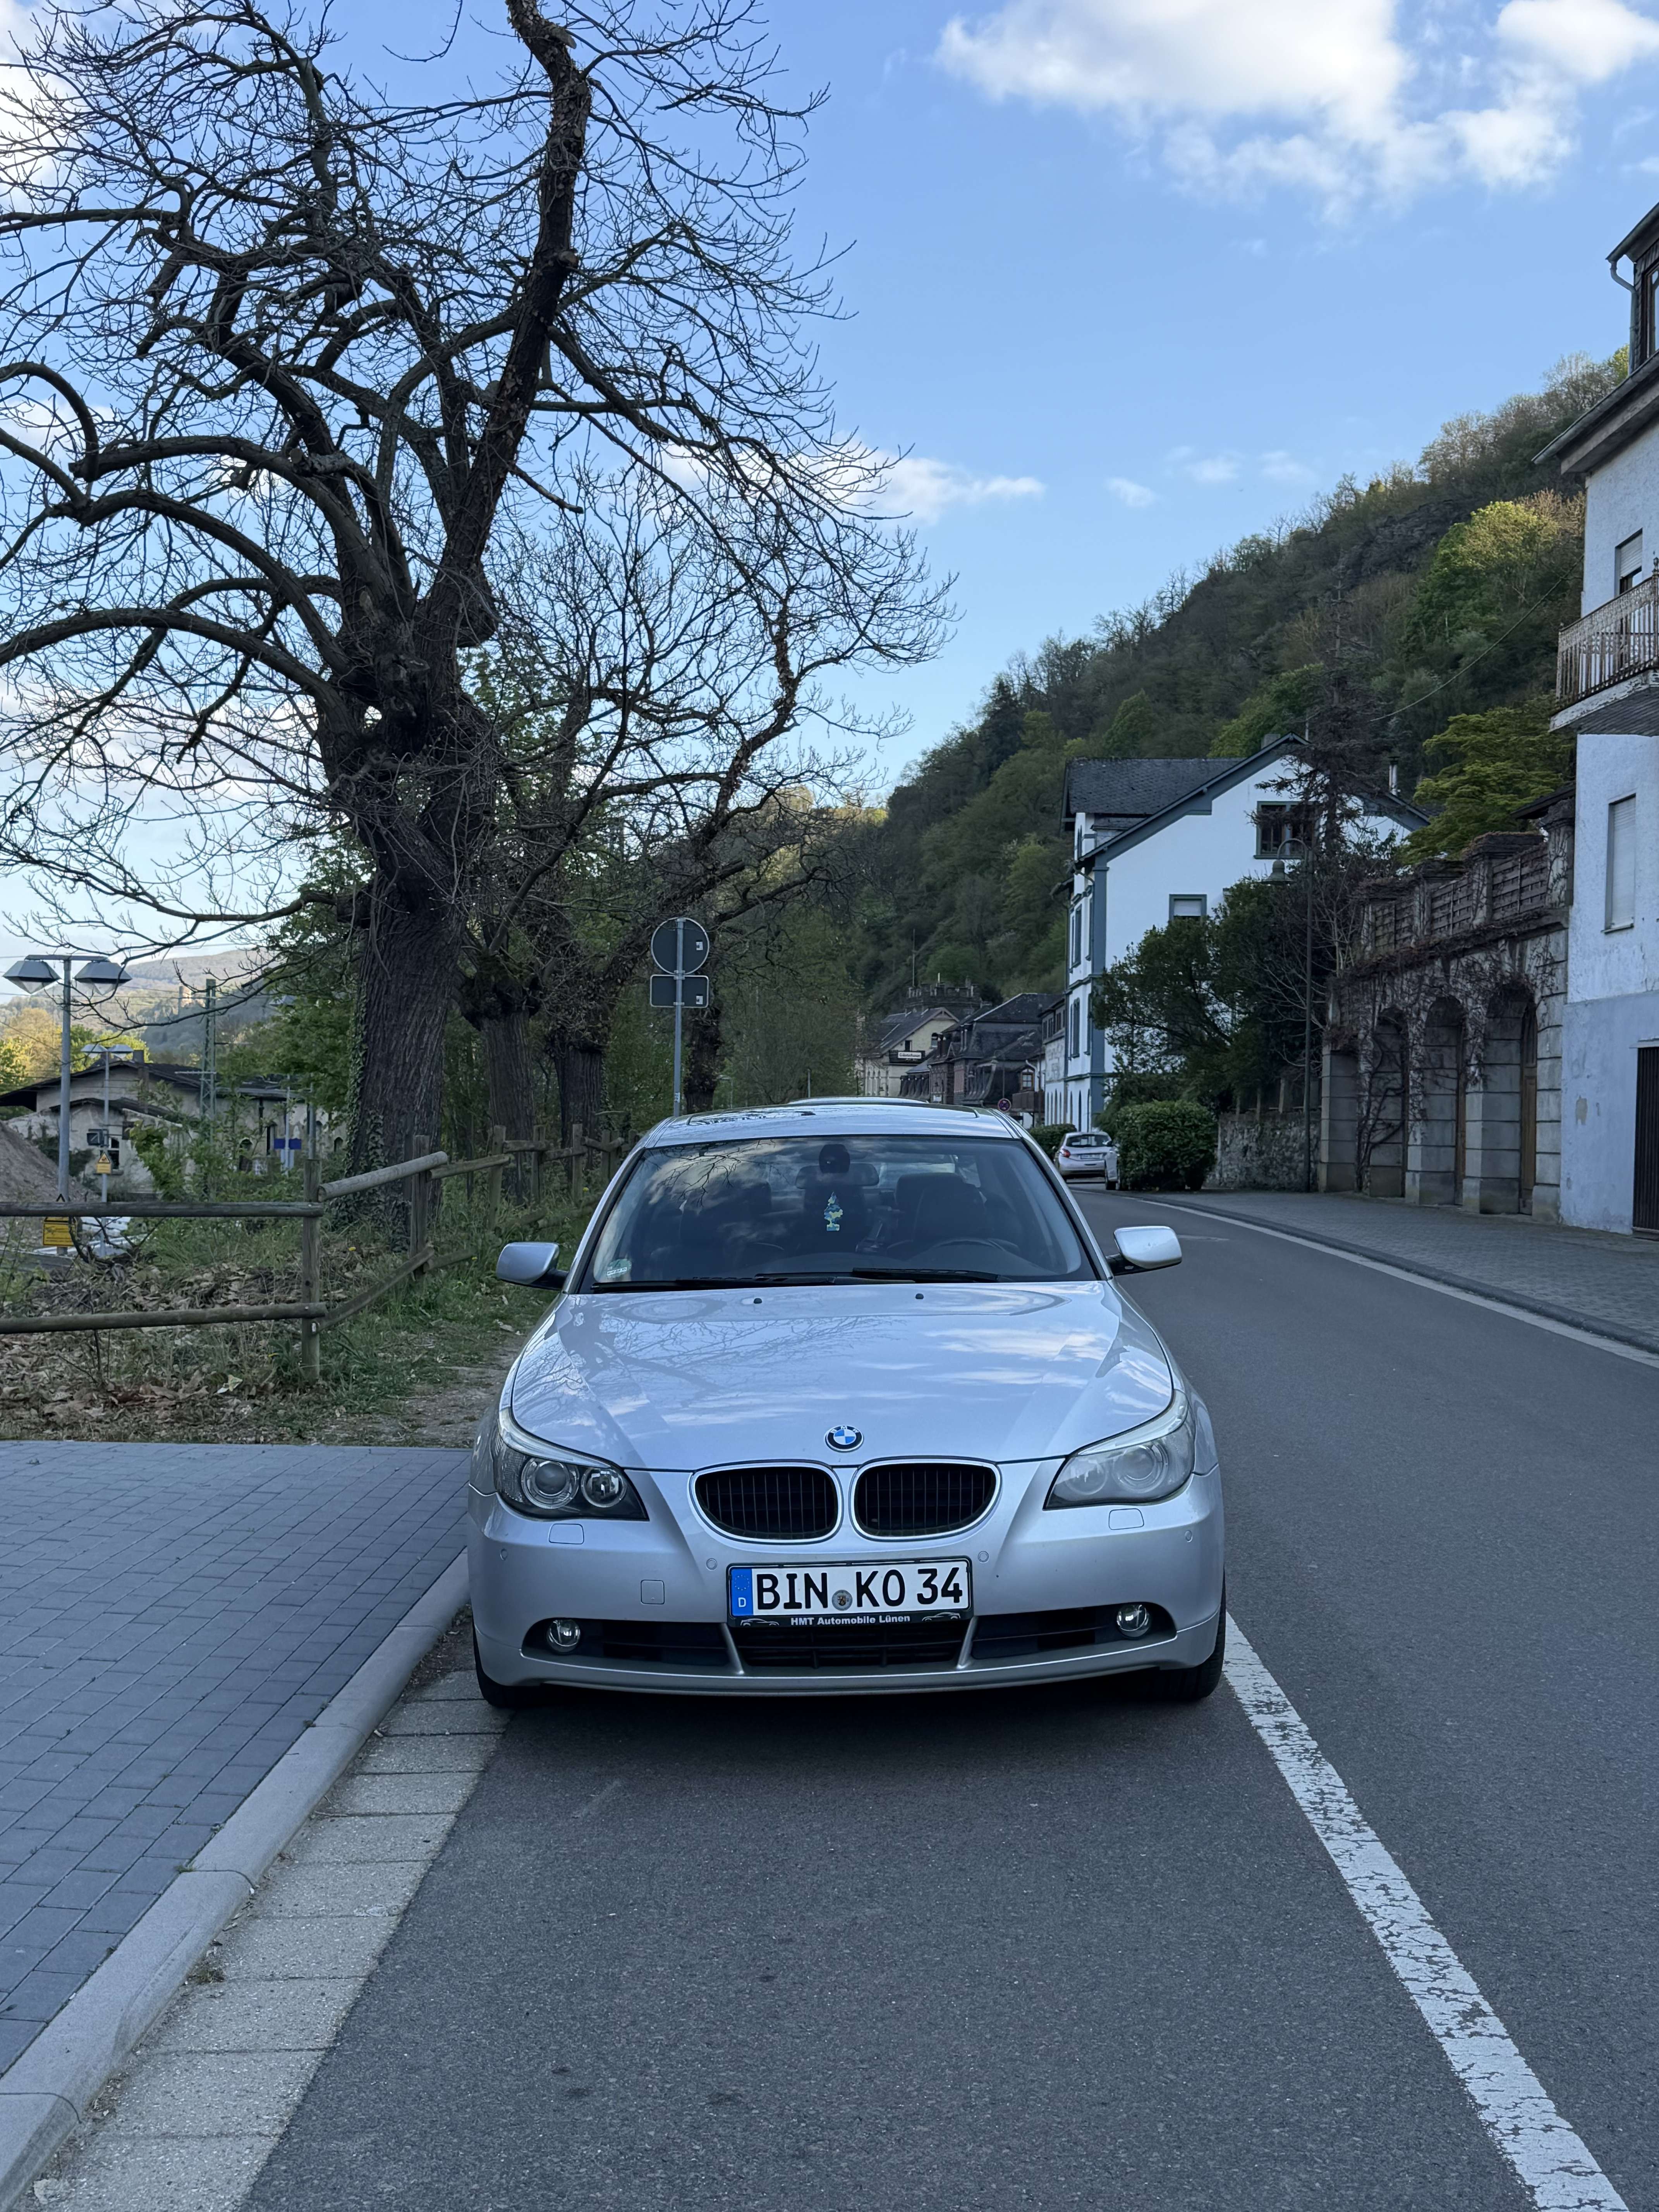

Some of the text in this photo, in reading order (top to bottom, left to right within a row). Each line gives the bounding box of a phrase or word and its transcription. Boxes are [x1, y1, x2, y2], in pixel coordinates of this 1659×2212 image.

[830, 1425, 859, 1434] BMW
[757, 1567, 963, 1610] BIN KO 34
[738, 1597, 746, 1607] D
[791, 1617, 814, 1625] HMT
[817, 1616, 876, 1625] Automobile
